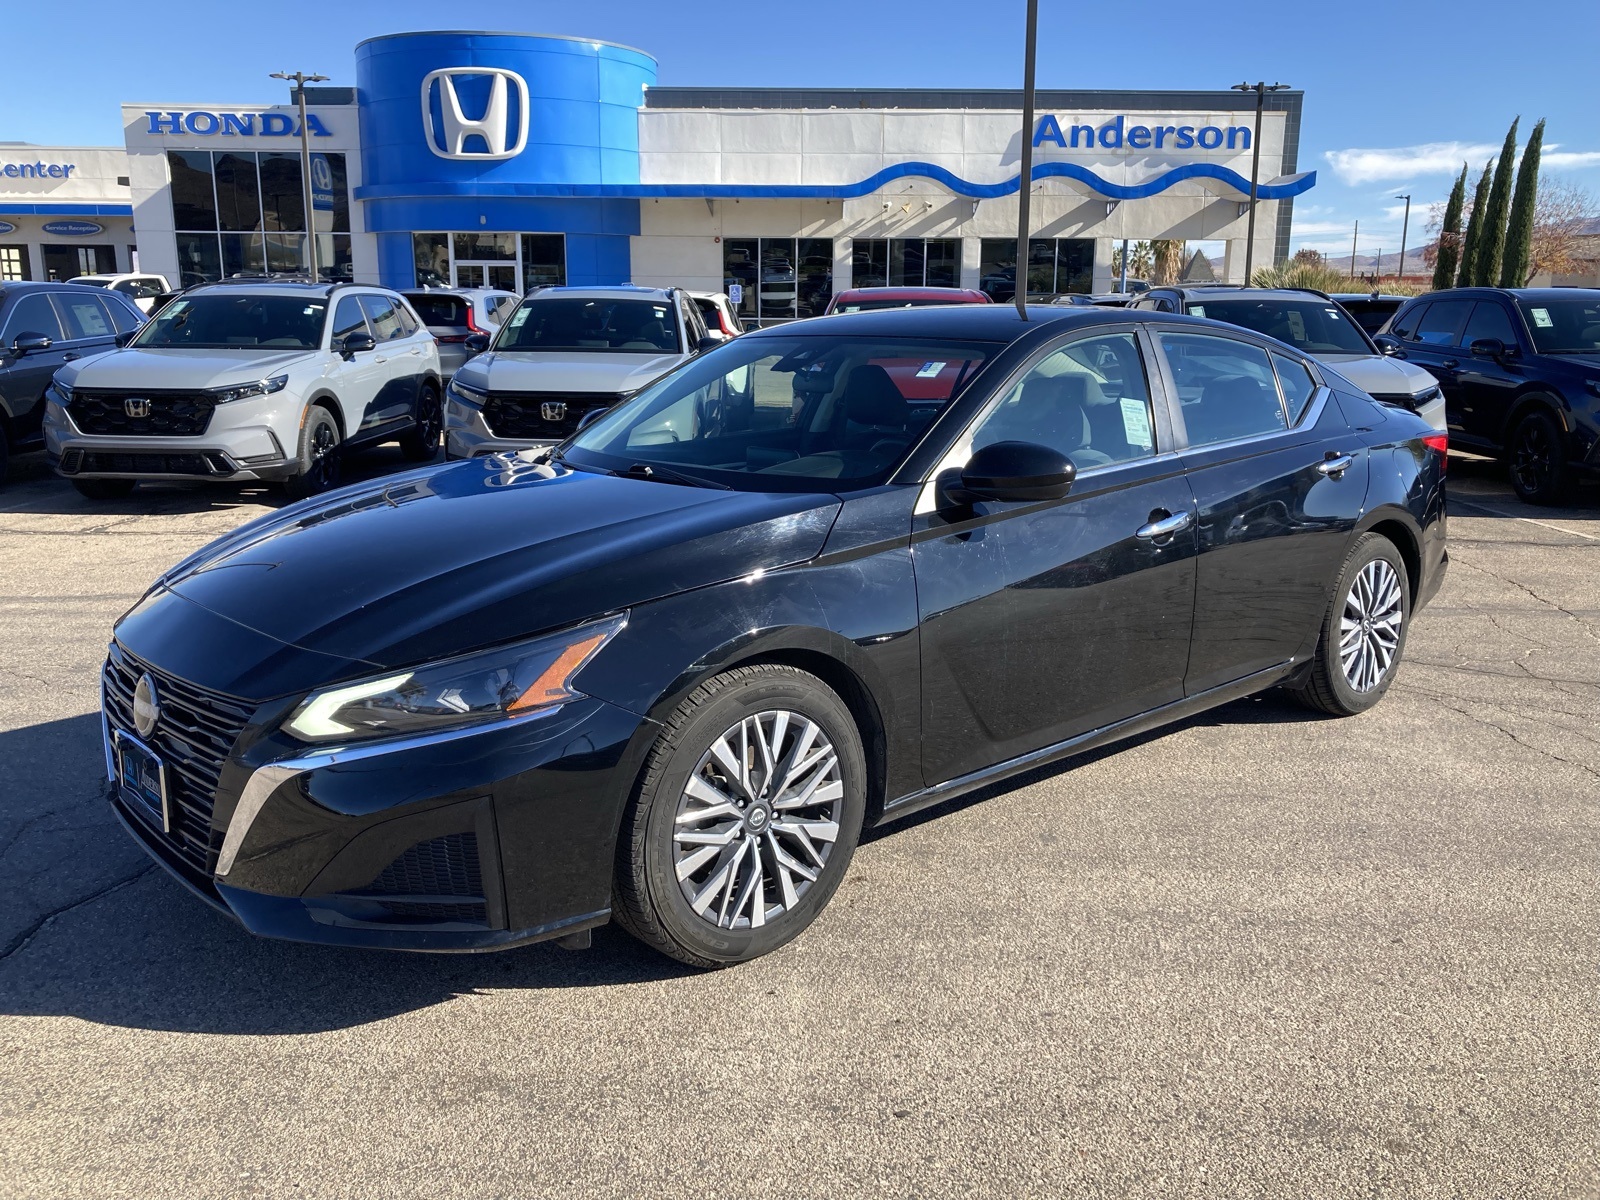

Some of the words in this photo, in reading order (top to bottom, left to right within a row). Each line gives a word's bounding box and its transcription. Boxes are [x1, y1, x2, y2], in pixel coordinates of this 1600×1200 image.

[145, 111, 333, 137] HONDA
[1033, 114, 1251, 149] Anderson
[0, 160, 75, 178] enter
